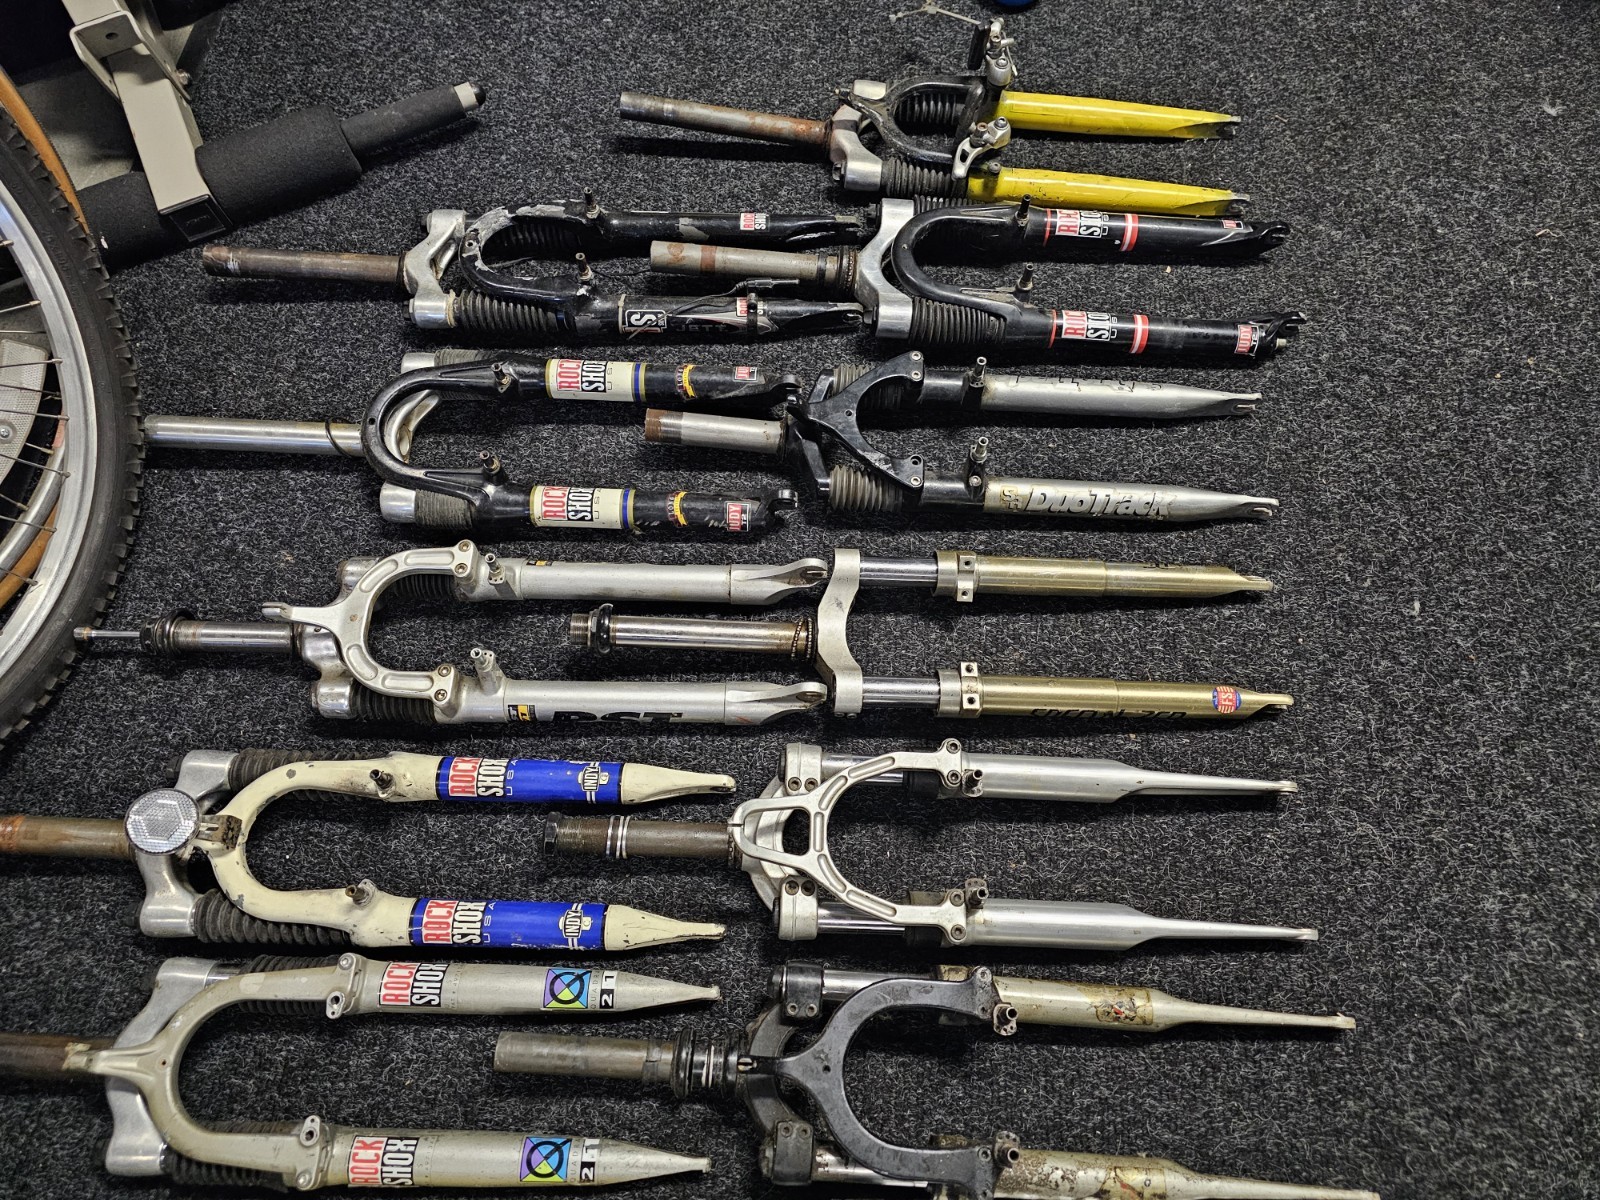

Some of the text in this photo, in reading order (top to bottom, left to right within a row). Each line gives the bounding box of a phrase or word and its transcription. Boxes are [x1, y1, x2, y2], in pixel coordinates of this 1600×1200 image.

[742, 212, 754, 229] ROC
[755, 212, 767, 230] SHO
[1057, 209, 1079, 235] ROC
[1080, 210, 1101, 236] SHO
[1064, 310, 1086, 337] ROC
[1086, 311, 1110, 339] SHO
[1236, 325, 1253, 353] JUDY
[728, 504, 741, 530] JUDY
[1221, 692, 1233, 706] FS
[449, 756, 482, 795] ROCK
[477, 758, 510, 797] SHOX
[583, 766, 600, 790] INDY
[423, 900, 457, 943] ROCK
[452, 901, 487, 944] SHOX
[483, 901, 497, 943] USA
[565, 910, 581, 937] INDY
[381, 963, 419, 1003] ROCK
[410, 964, 448, 1006] SHOX
[601, 975, 615, 1007] 21
[349, 1139, 385, 1185] ROCK
[381, 1138, 418, 1186] SHOX
